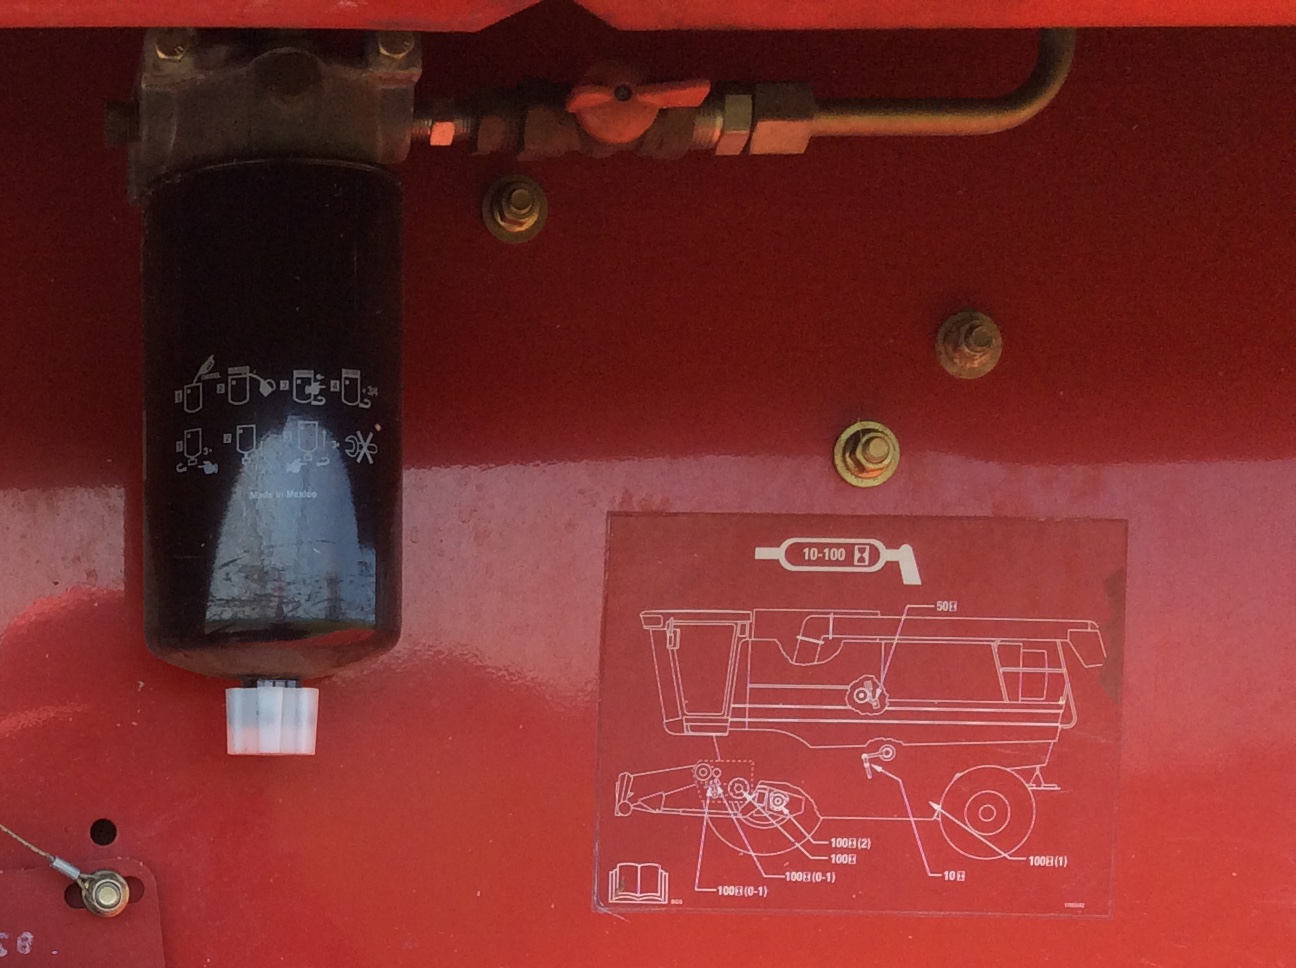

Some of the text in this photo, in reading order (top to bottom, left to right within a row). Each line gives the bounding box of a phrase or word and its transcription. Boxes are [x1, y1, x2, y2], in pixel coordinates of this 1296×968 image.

[286, 489, 318, 499] Mexico
[803, 547, 846, 561] 10-100
[936, 601, 949, 612] 50
[830, 838, 872, 850] 100 (2)
[830, 854, 848, 865] 100
[1029, 856, 1068, 868] 100 (1)
[785, 872, 836, 883] 100 (0-1)
[943, 871, 955, 881] 10
[717, 886, 768, 897] 100 (0-1)
